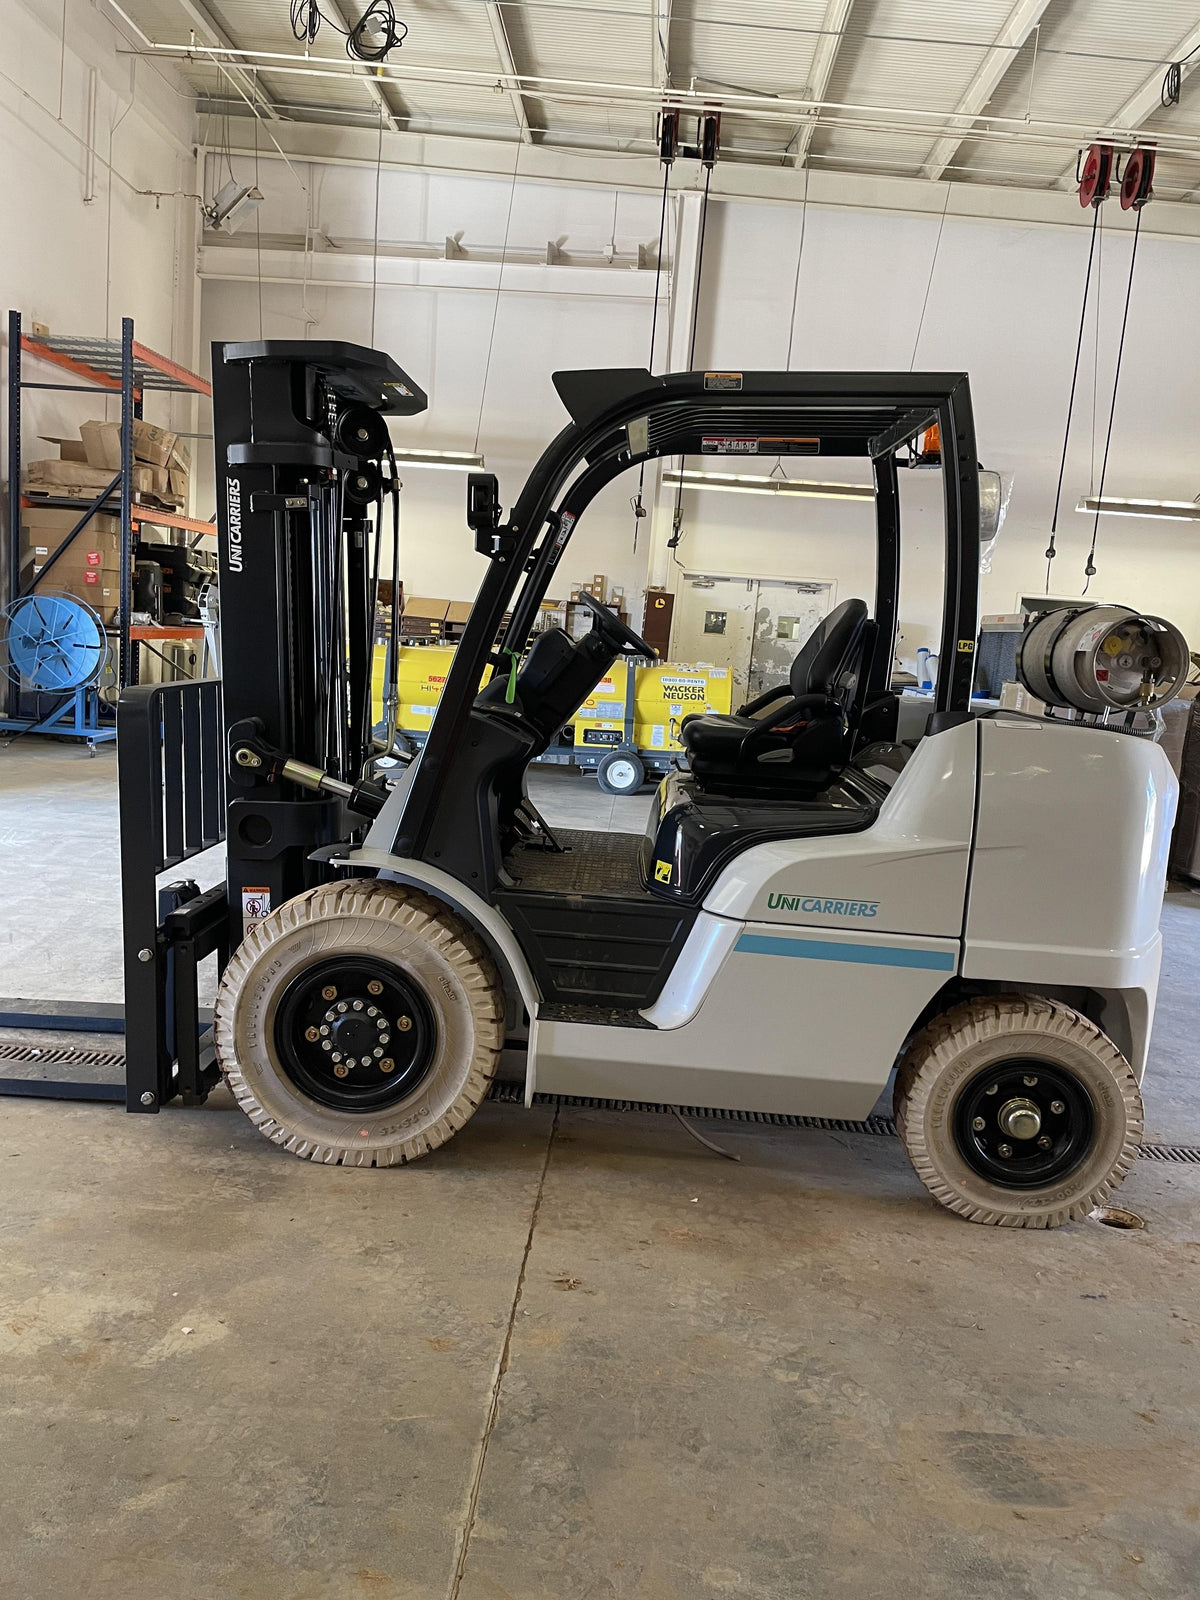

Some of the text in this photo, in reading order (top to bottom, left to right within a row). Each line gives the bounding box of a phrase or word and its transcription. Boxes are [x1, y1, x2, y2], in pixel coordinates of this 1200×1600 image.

[227, 477, 243, 572] UNICARRIERS
[959, 642, 973, 650] LPG
[663, 685, 704, 694] WACKER
[663, 692, 704, 700] NEUSON
[767, 892, 880, 917] UNICARRIERS
